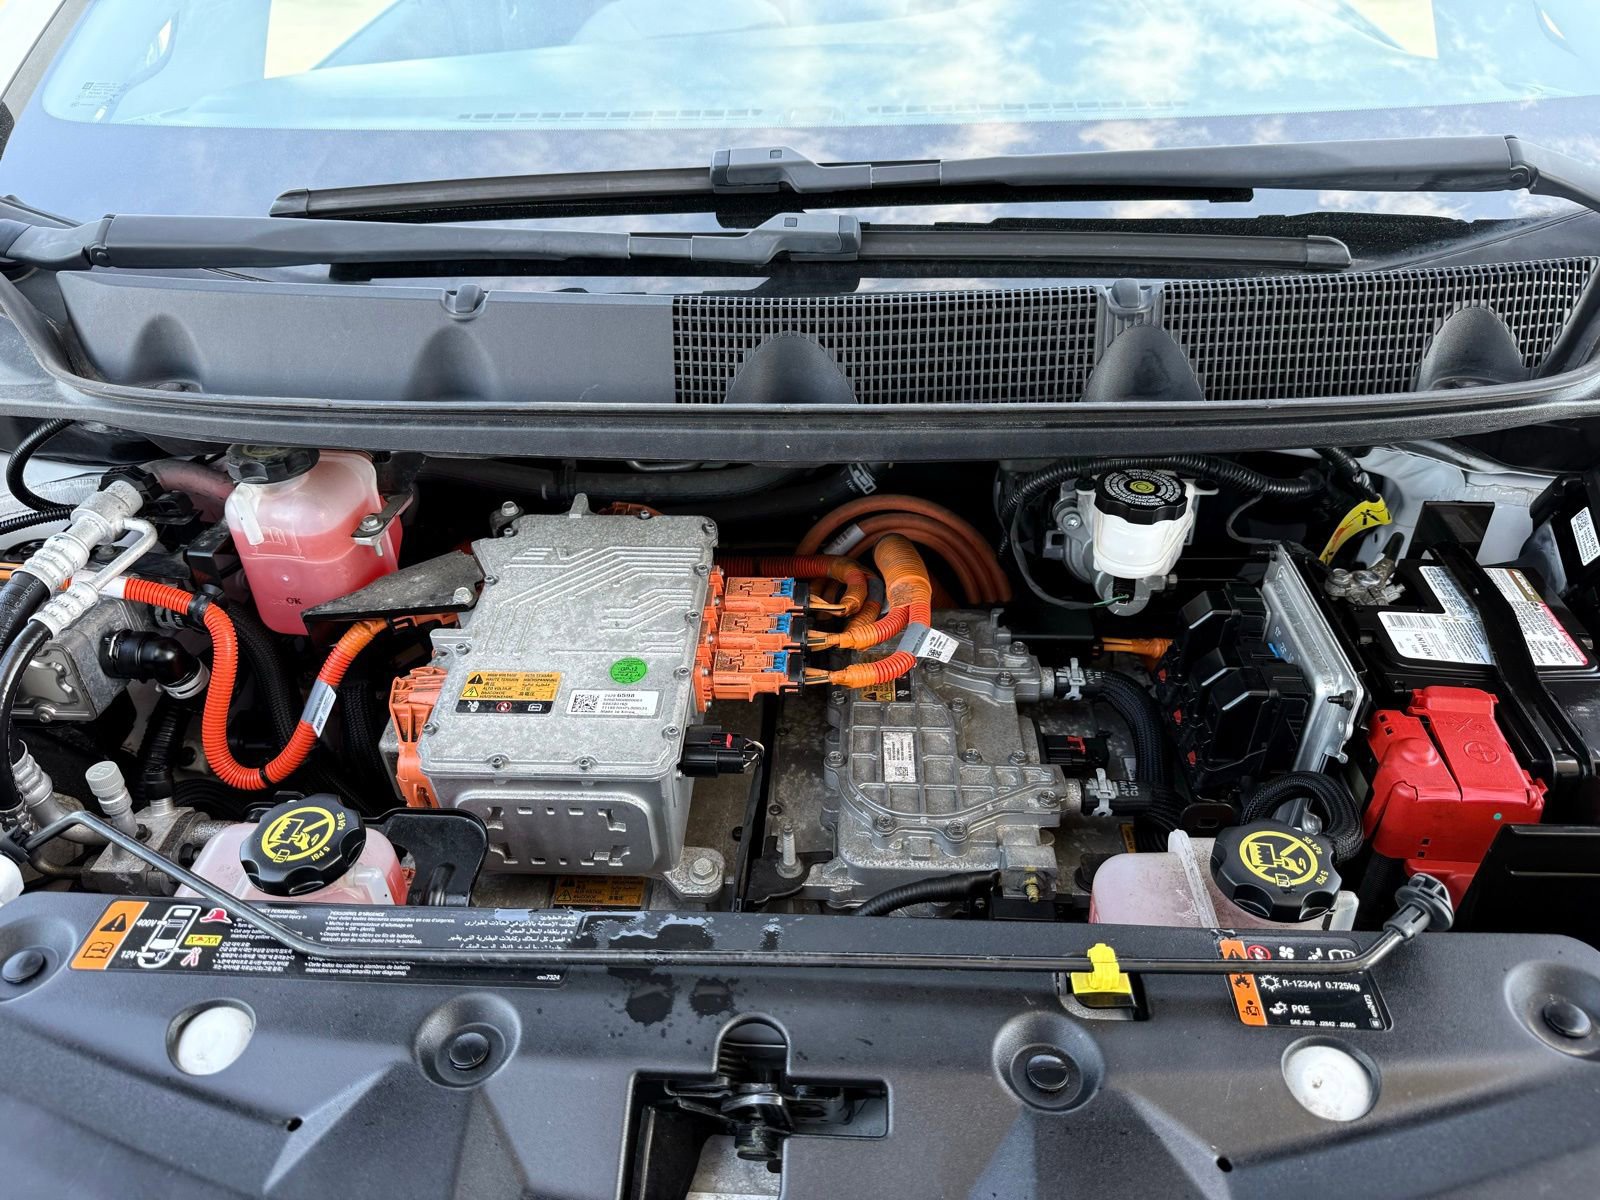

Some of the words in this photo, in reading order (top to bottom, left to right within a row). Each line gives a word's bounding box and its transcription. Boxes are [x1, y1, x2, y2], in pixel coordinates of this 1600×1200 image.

[136, 918, 157, 928] 400V
[121, 951, 136, 959] 12V
[1325, 981, 1361, 993] 0.725kg
[1291, 1005, 1311, 1014] POE
